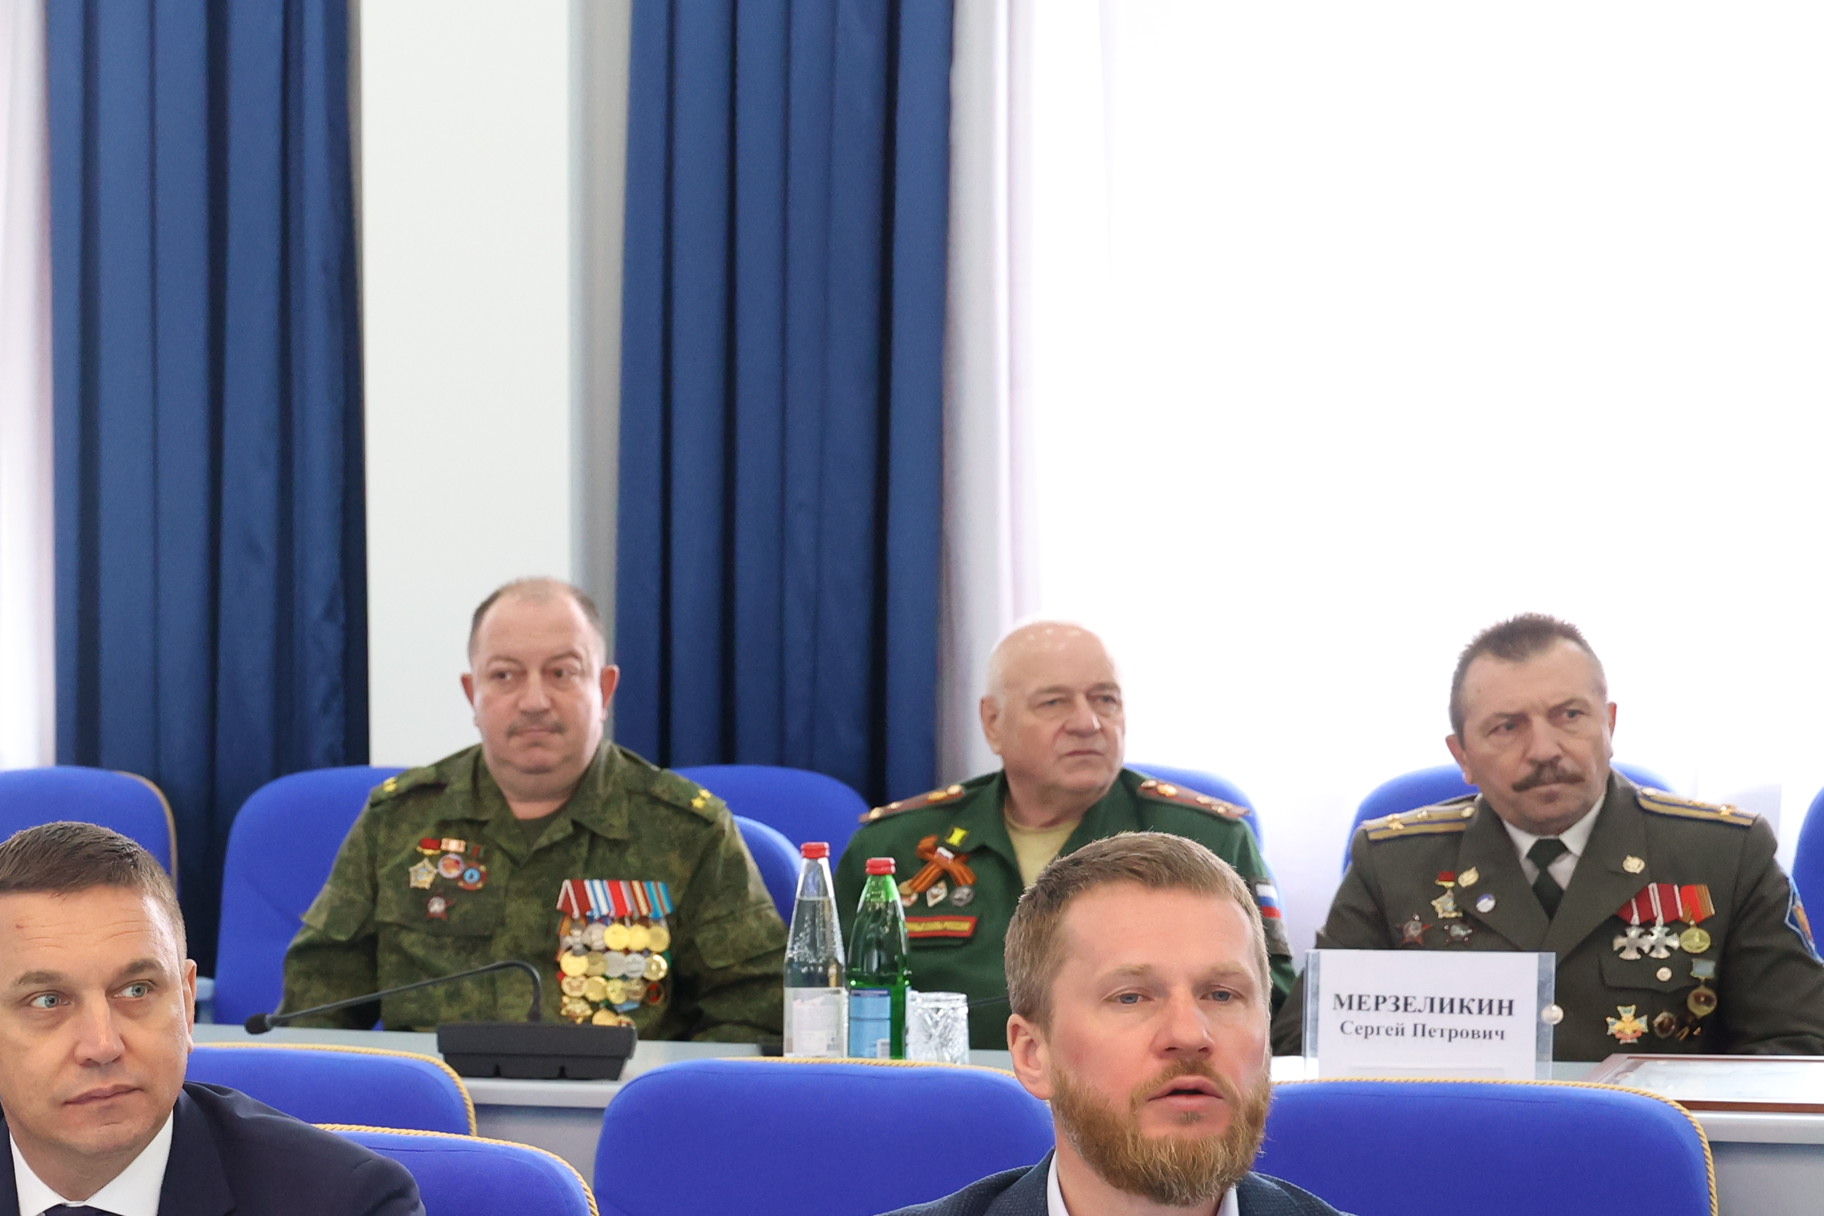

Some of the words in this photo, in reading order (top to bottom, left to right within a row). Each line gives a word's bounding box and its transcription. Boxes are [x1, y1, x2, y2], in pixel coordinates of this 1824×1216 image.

[1334, 993, 1515, 1017] МЕРЗЕЛИКИН
[1339, 1020, 1405, 1040] Сергей
[1412, 1023, 1506, 1043] Петрович
